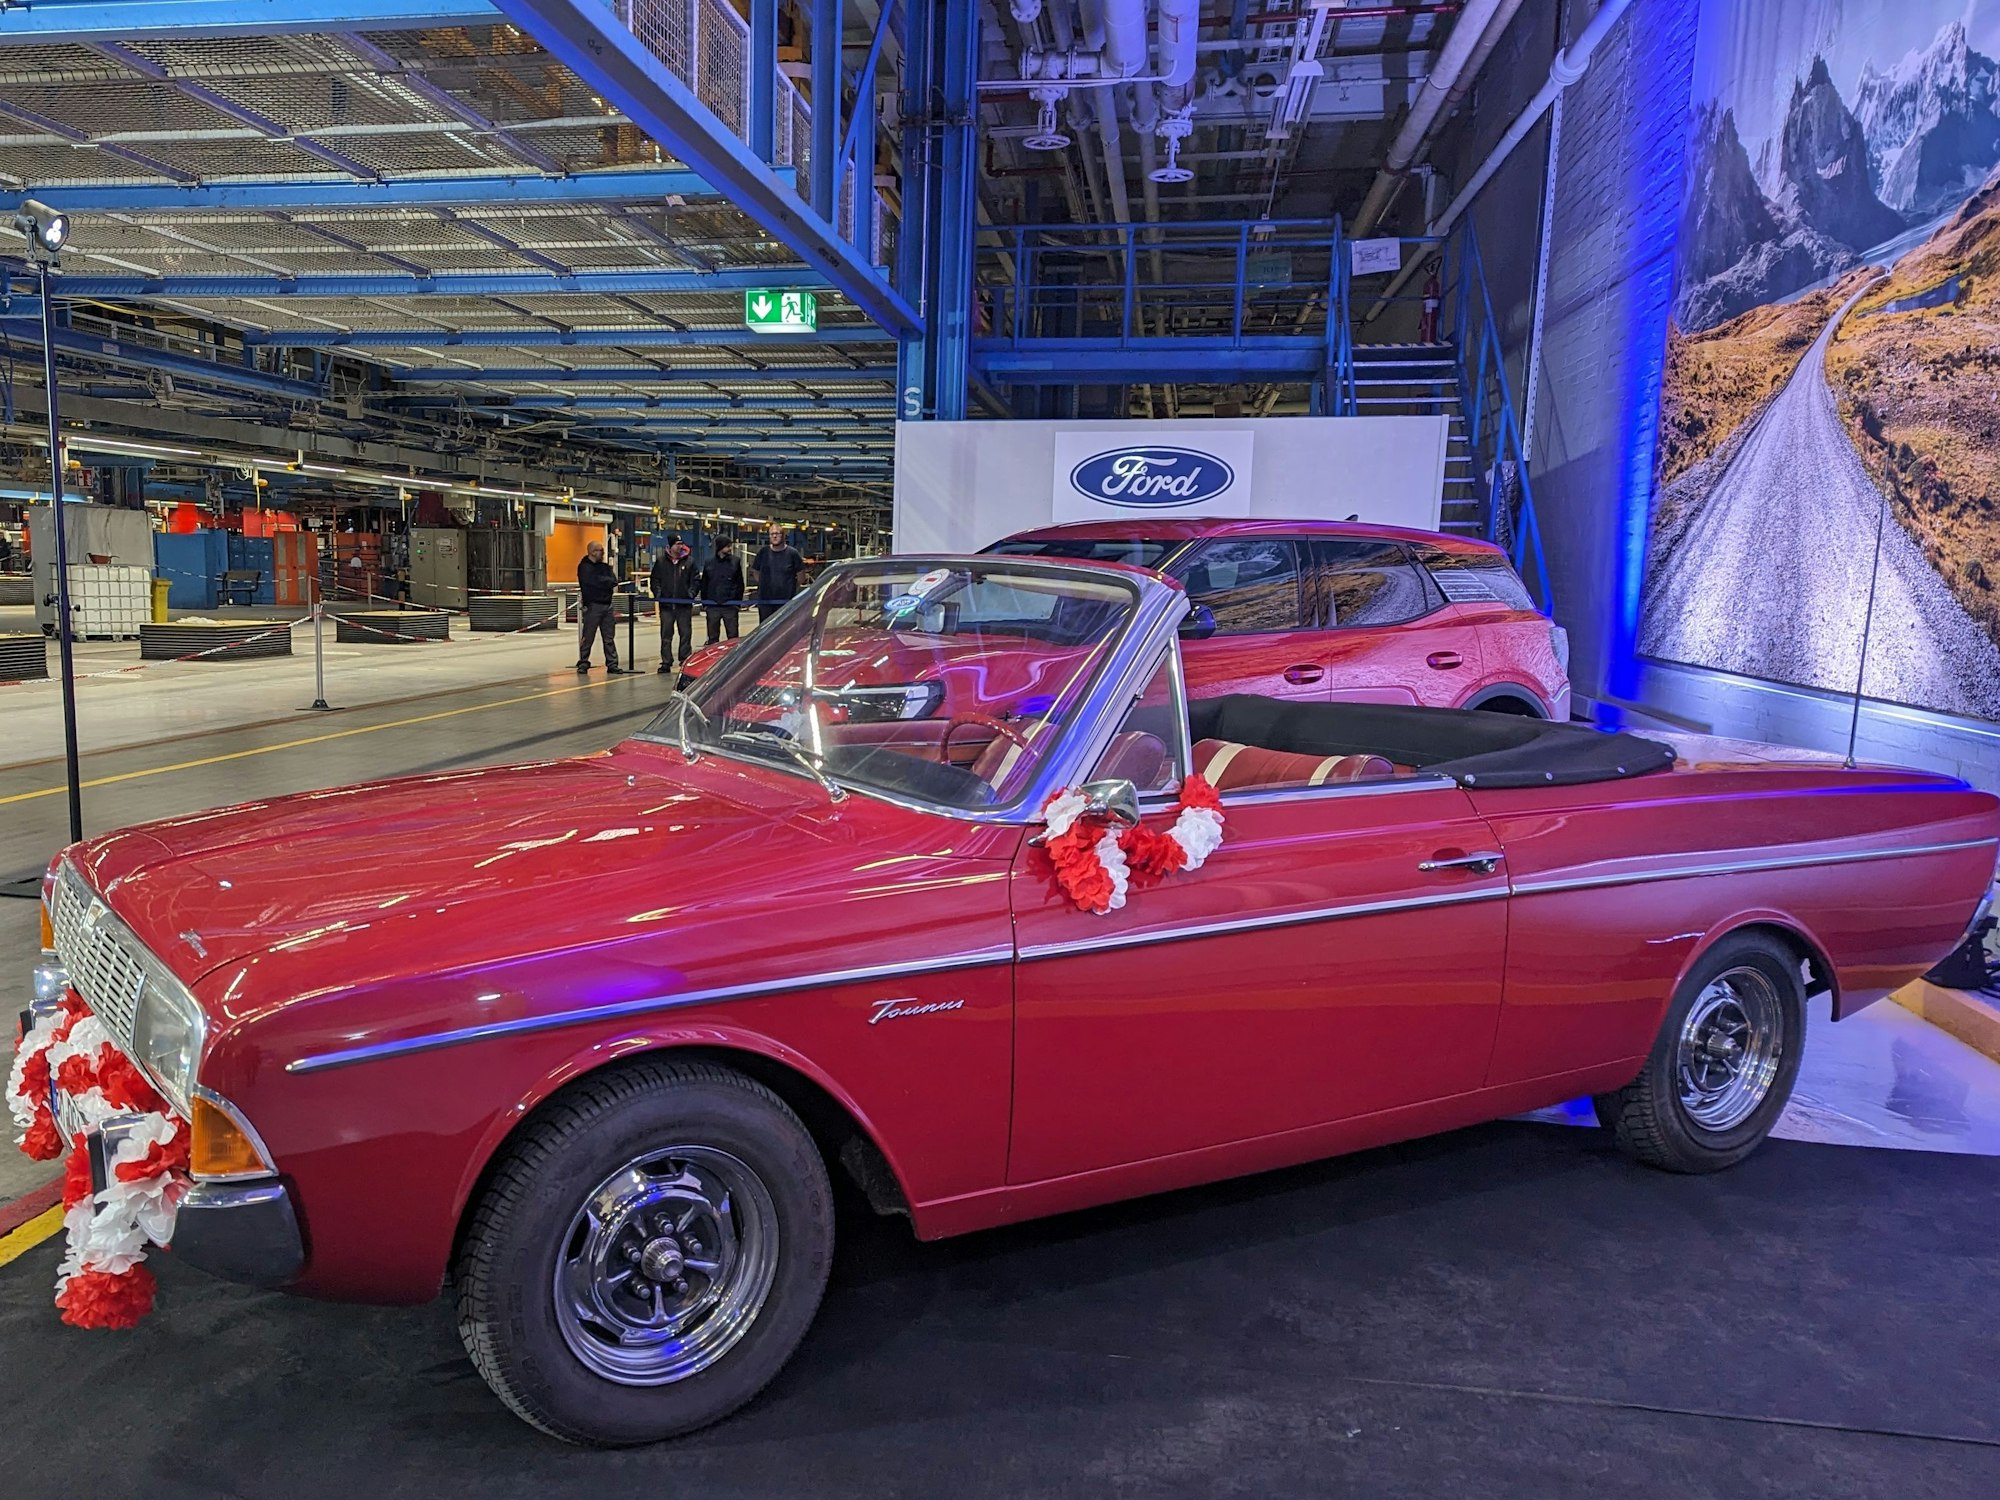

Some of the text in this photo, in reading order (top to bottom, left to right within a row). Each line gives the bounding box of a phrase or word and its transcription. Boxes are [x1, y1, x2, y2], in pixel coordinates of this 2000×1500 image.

[903, 386, 922, 417] S
[1101, 455, 1202, 497] Ford
[867, 997, 965, 1025] Taunus
